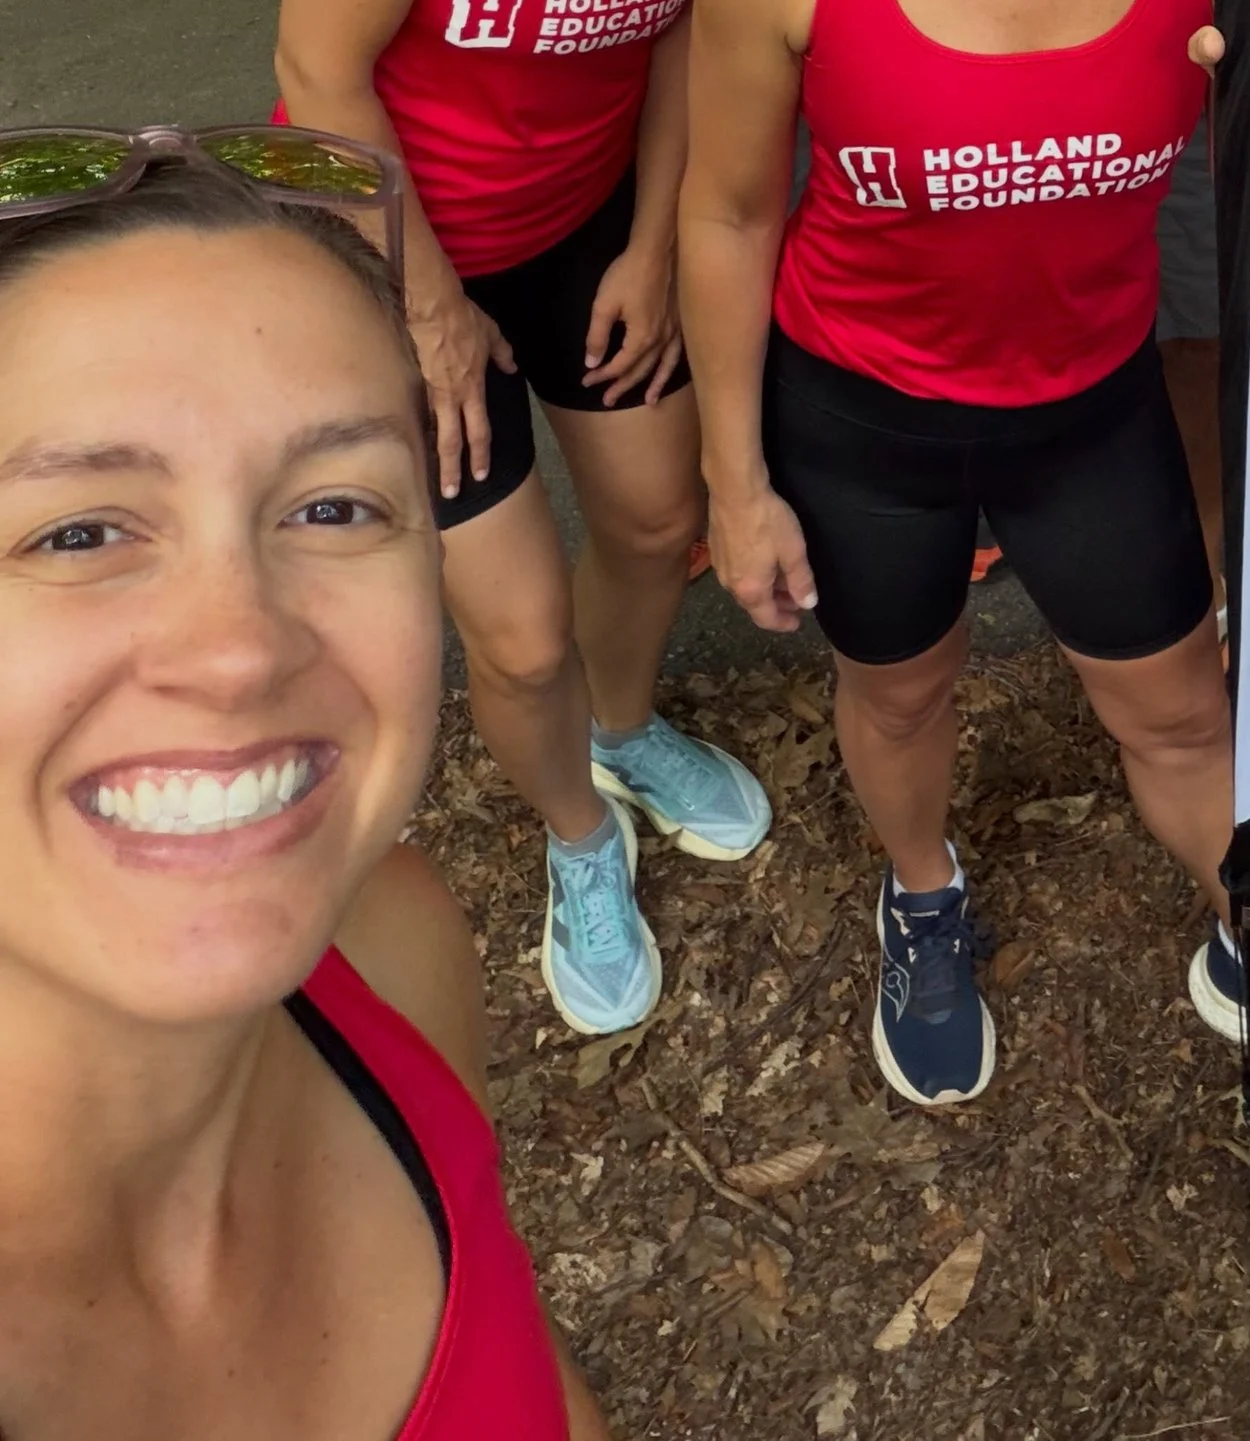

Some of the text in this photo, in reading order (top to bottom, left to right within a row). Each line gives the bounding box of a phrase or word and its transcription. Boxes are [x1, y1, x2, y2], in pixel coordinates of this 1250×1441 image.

[922, 133, 1122, 172] HOLLAND
[925, 136, 1185, 195] EDUCATIONAL
[929, 162, 1173, 212] FOUNDATION
